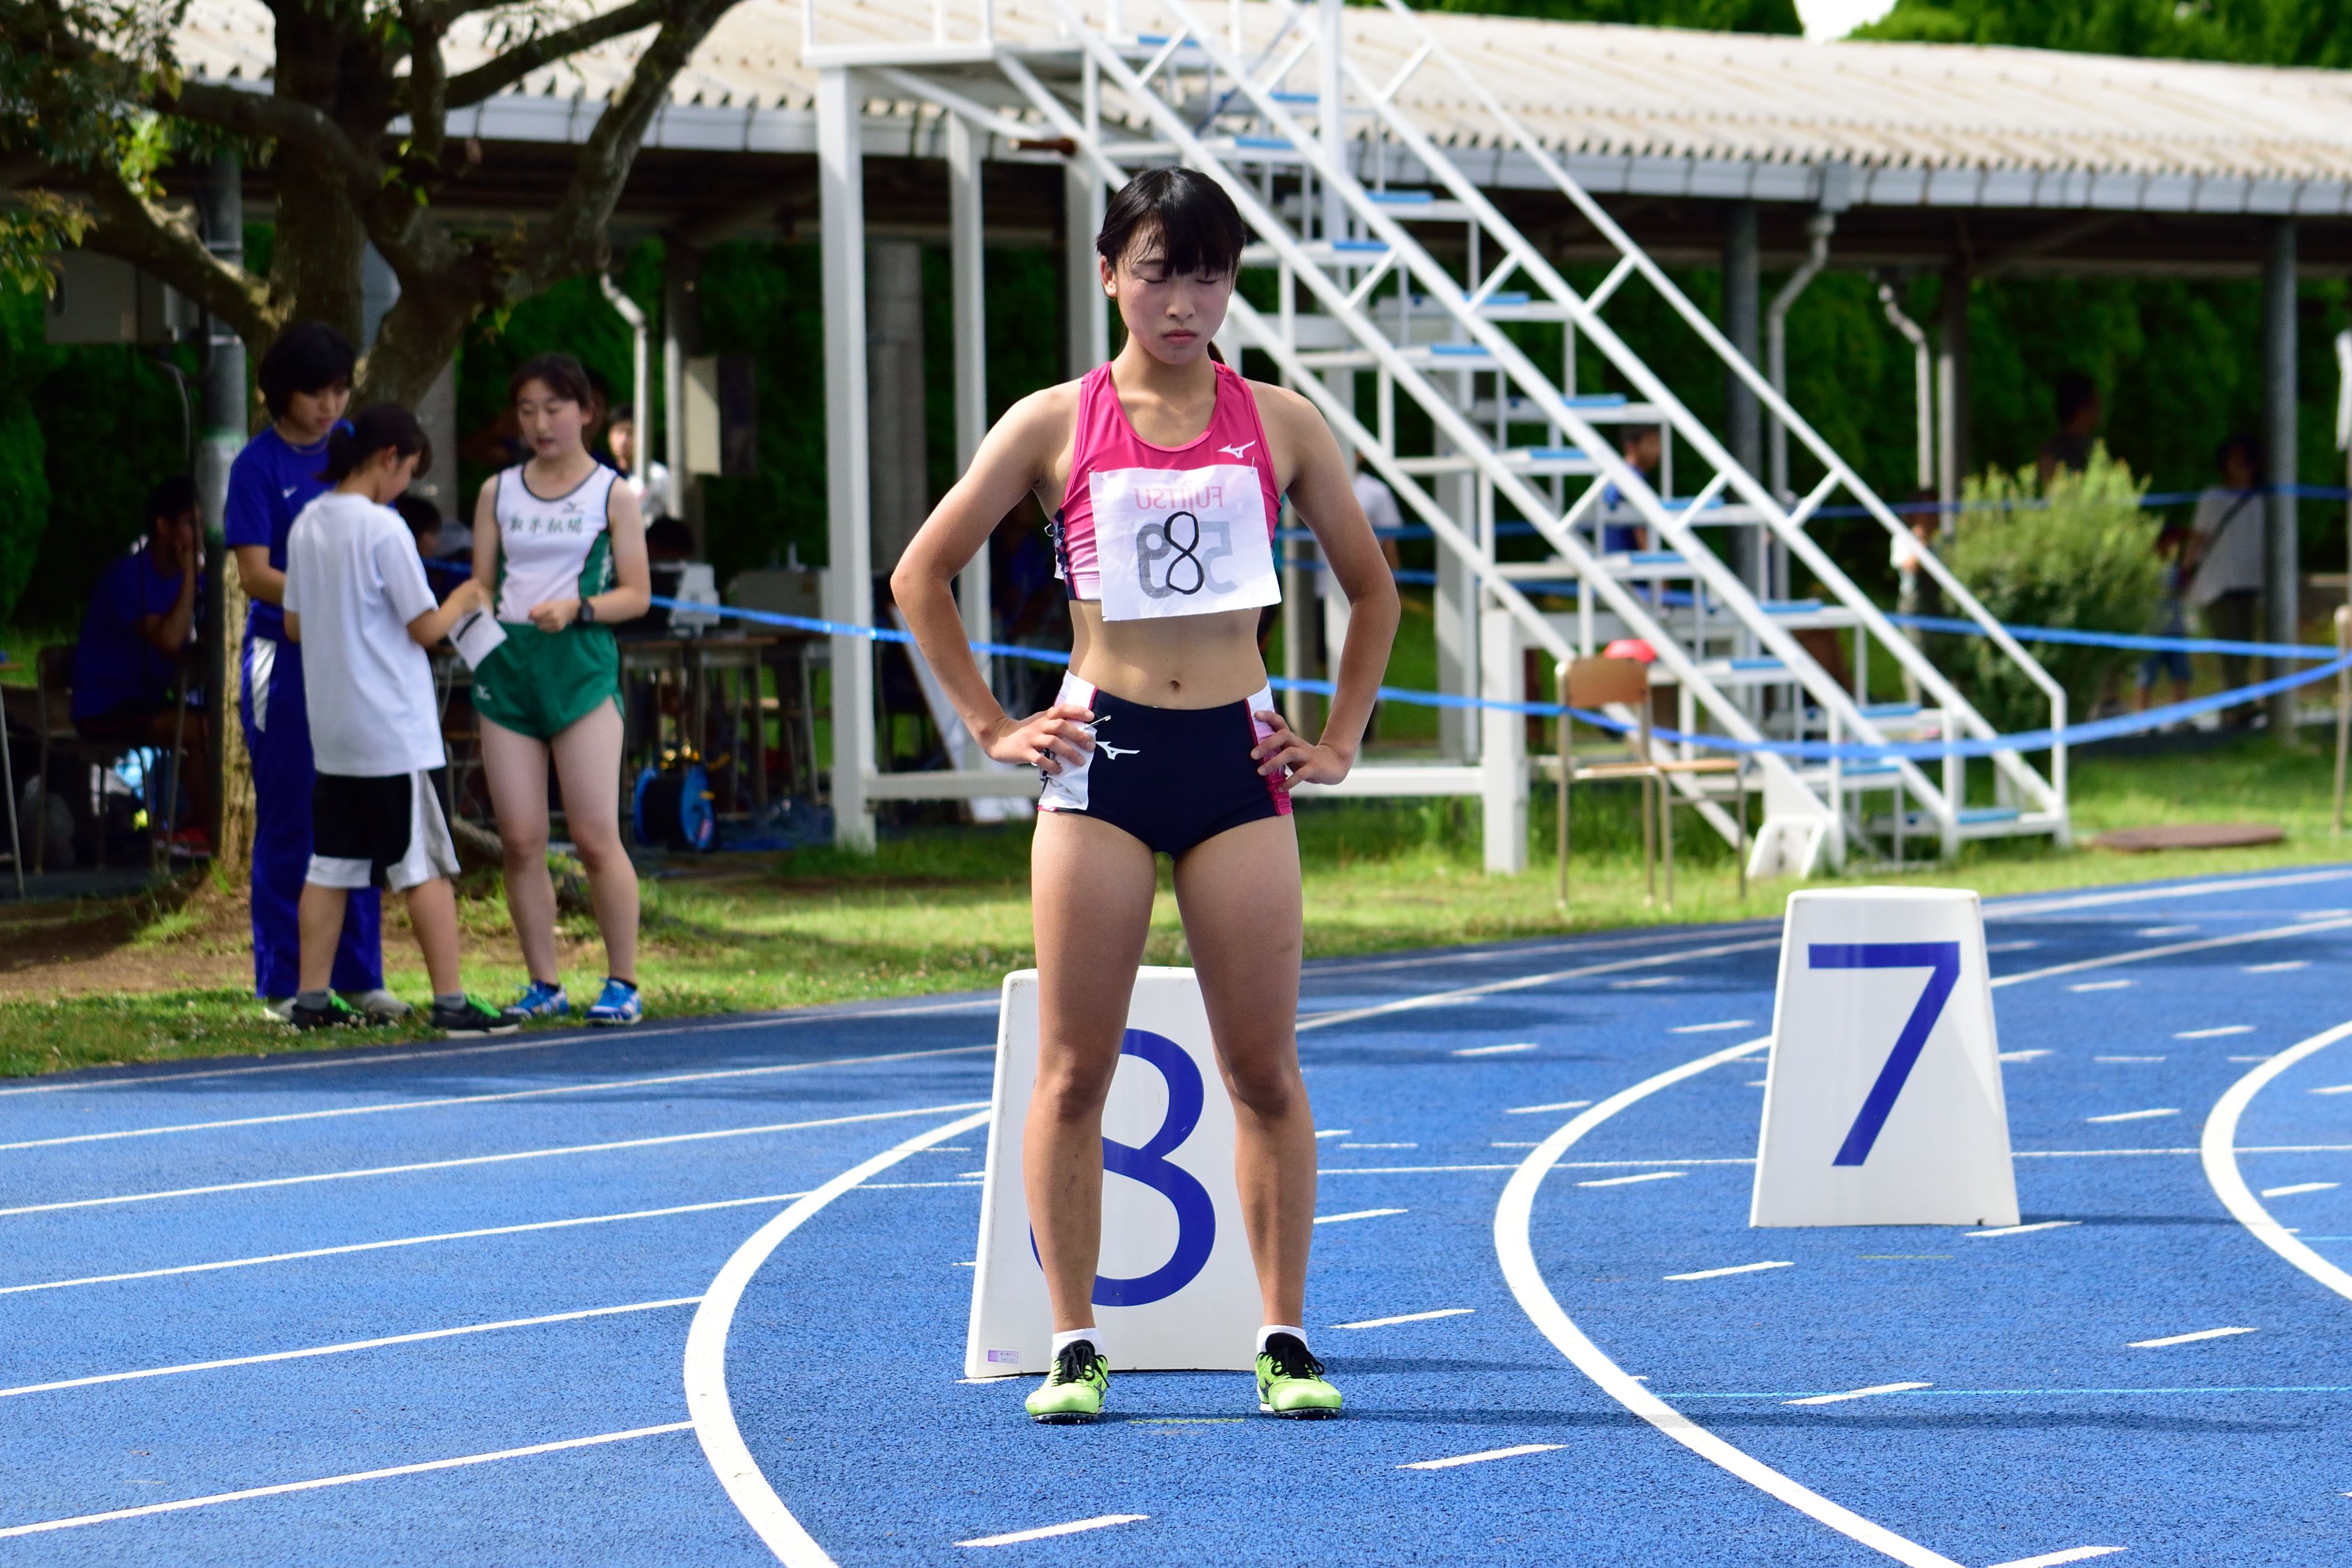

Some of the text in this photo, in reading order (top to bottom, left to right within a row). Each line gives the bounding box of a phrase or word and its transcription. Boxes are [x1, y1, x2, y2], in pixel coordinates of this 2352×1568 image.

[1163, 510, 1205, 595] 8
[1808, 940, 1961, 1167] 7
[1030, 1028, 1216, 1307] 8
